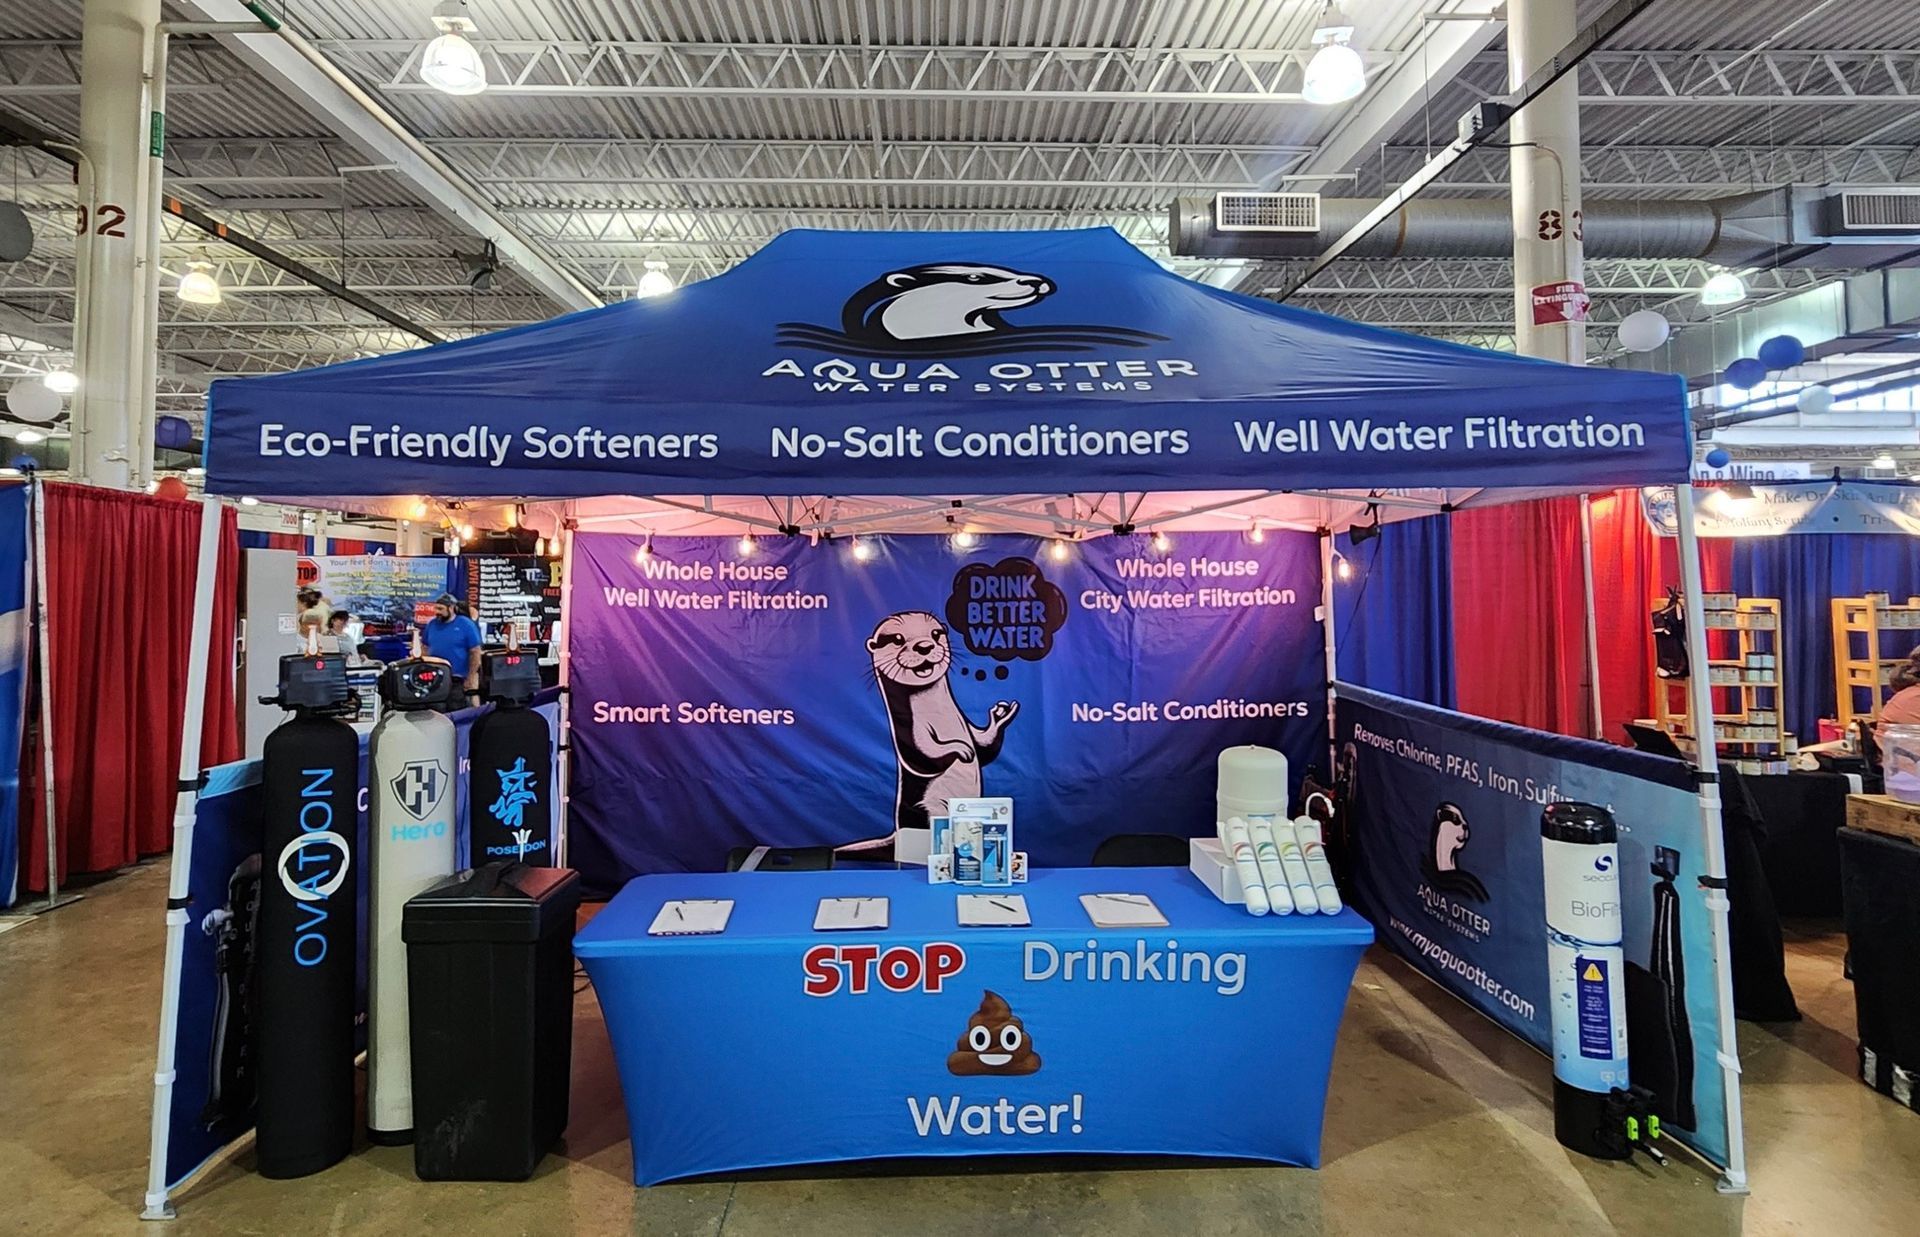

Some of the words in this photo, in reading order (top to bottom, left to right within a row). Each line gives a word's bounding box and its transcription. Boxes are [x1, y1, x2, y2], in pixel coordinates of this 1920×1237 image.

[761, 359, 960, 383] AQUA
[989, 359, 1199, 379] OTTER
[813, 382, 948, 393] WATER
[975, 381, 1153, 393] SYSTEMS
[259, 424, 512, 467] Eco-Friendly
[523, 424, 718, 460] Softeners
[771, 426, 923, 458] No-Salt
[934, 423, 1190, 457] Conditioners
[1235, 419, 1320, 455] Well
[1329, 418, 1453, 453] Water
[1465, 415, 1645, 450] Filtration
[1764, 492, 1801, 504] Make
[297, 567, 318, 580] TOP
[643, 561, 706, 581] Whole
[710, 562, 788, 581] House
[1116, 558, 1187, 578] Whole
[1190, 557, 1259, 578] House
[604, 588, 654, 608] Well
[658, 588, 723, 609] Water
[727, 588, 829, 610] Filtration
[969, 575, 1037, 602] DRINK
[1080, 588, 1121, 614] City
[1125, 588, 1191, 608] Water
[1195, 586, 1296, 607] Filtration
[968, 601, 1046, 625] BETTER
[971, 626, 1046, 650] WATER
[593, 702, 671, 724] Smart
[675, 702, 795, 726] Softeners
[1071, 703, 1157, 723] No-Salt
[1162, 700, 1309, 722] Conditioners
[1354, 723, 1395, 754] Removes
[1396, 738, 1443, 773] Chlorine,
[1446, 754, 1484, 788] PFAS,
[1488, 766, 1523, 801] Iron,
[390, 821, 448, 843] Hero
[294, 768, 334, 967] OVATION
[1417, 883, 1448, 912] AQUA
[1451, 903, 1491, 936] OTTER
[803, 942, 967, 996] STOP
[1023, 939, 1247, 996] Drinking
[1390, 916, 1535, 1021] www.myaquaotter.com
[907, 1094, 1084, 1137] Water!
